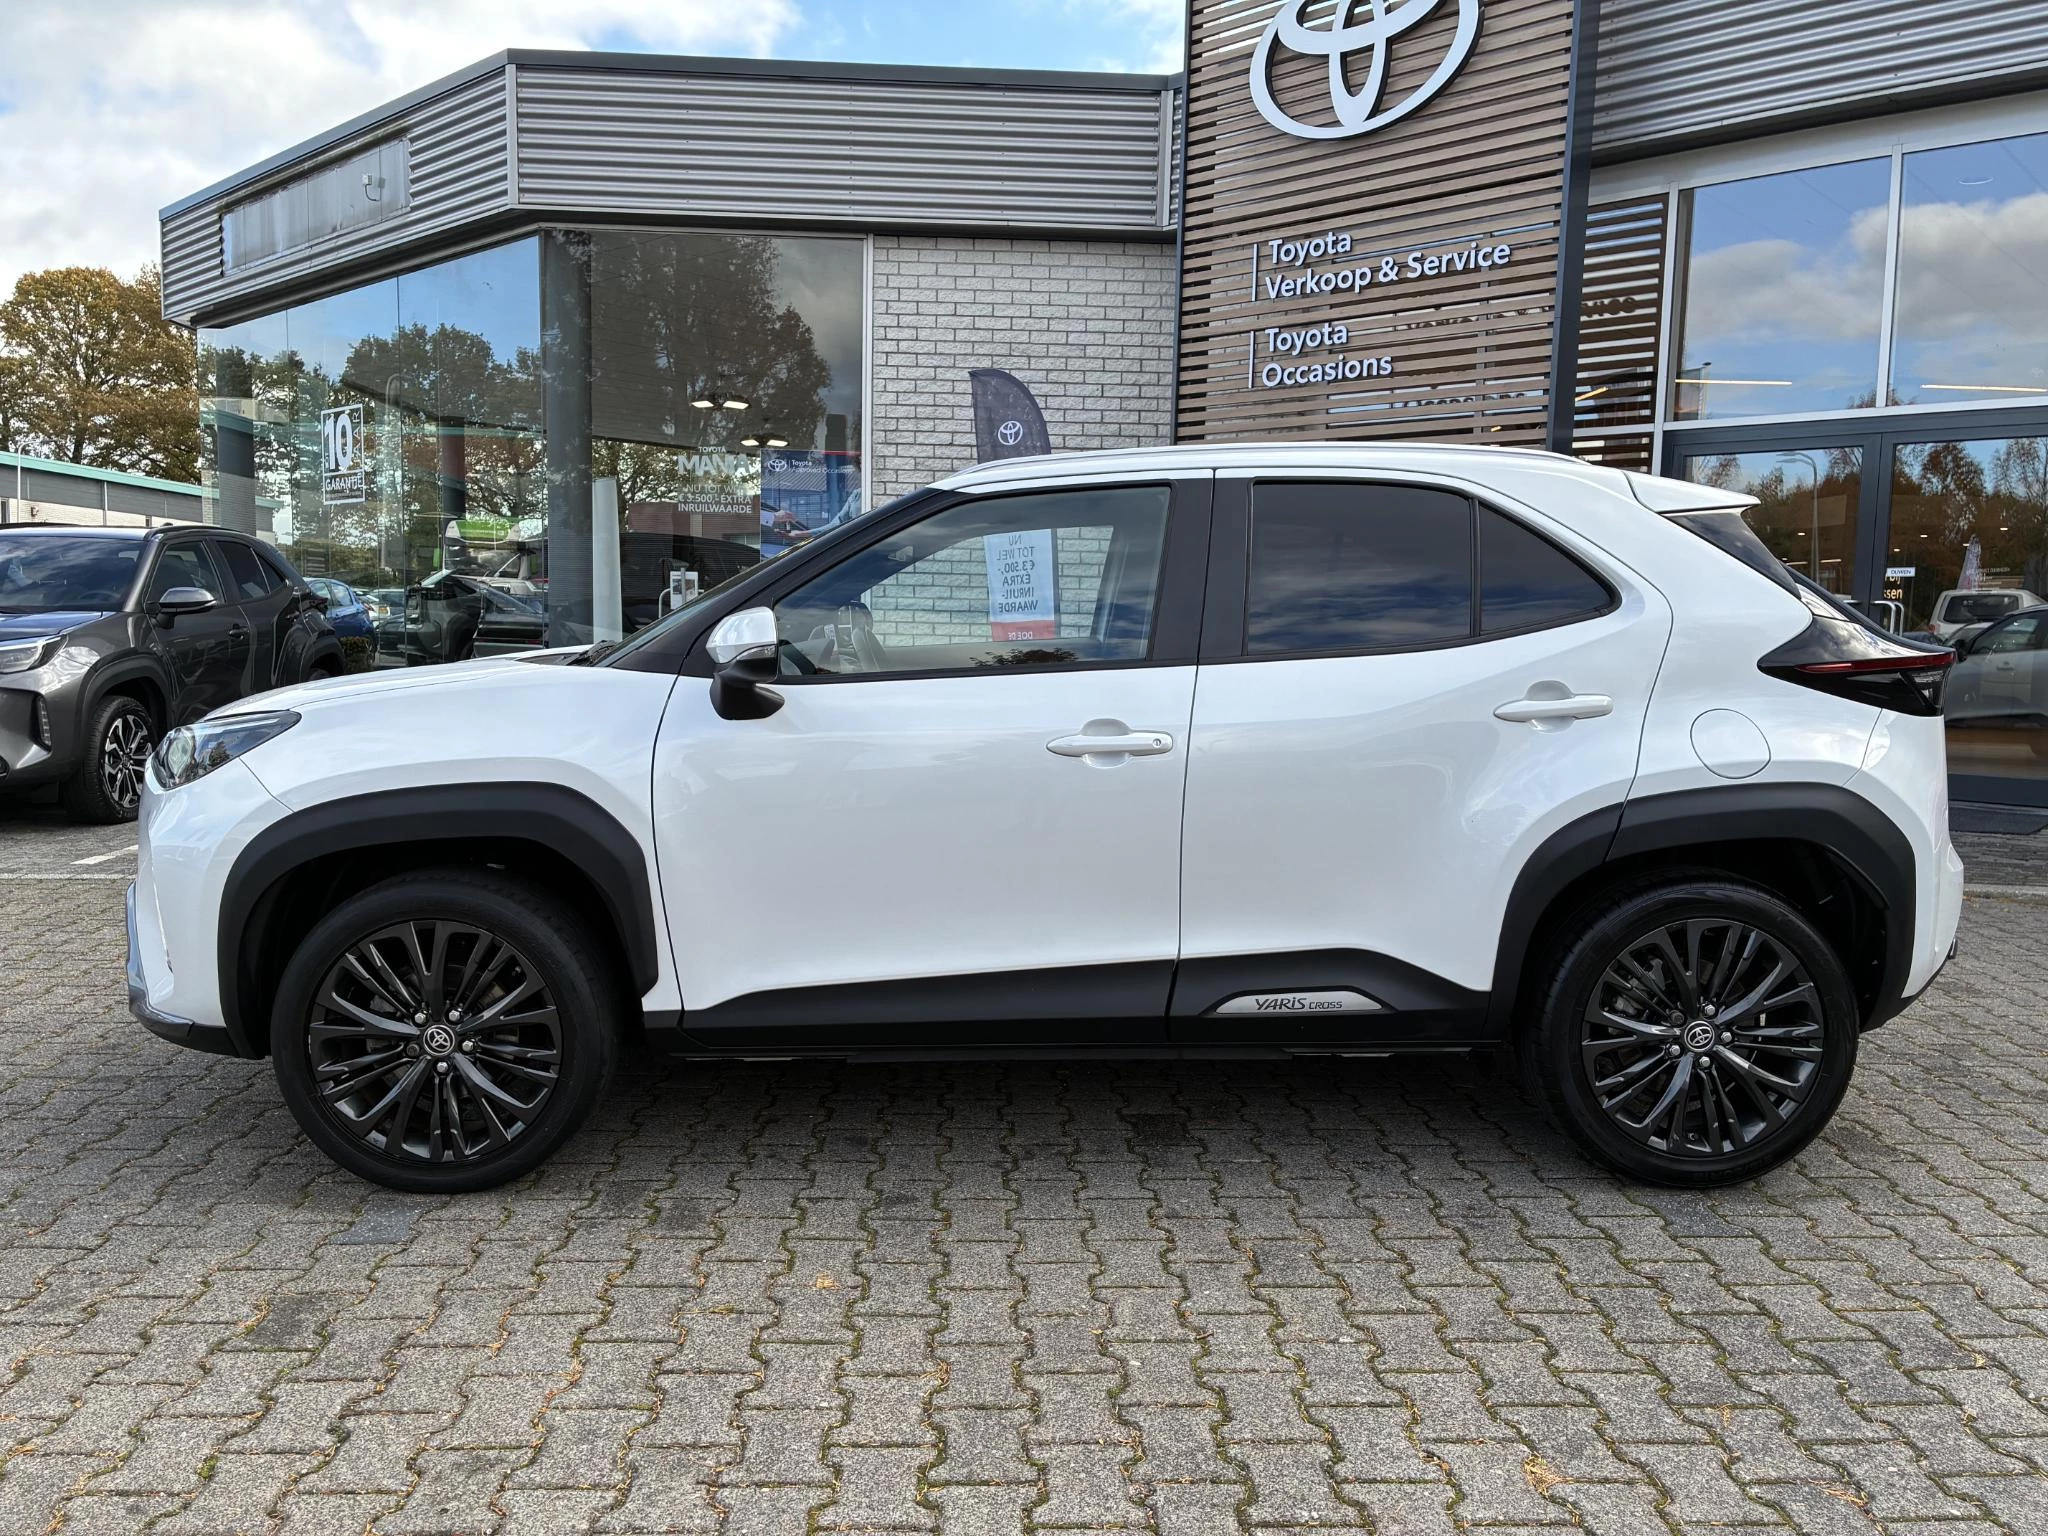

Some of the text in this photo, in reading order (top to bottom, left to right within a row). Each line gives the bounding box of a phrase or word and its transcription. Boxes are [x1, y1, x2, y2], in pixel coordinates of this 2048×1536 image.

[1268, 231, 1352, 267] Toyota
[1265, 241, 1511, 299] Verkoop & Service
[1264, 322, 1349, 356] Toyota
[1261, 353, 1393, 388] Occasions
[324, 413, 353, 470] 10
[678, 453, 750, 476] MANIA
[687, 484, 701, 493] NU
[677, 503, 753, 514] INRUILWAARDE
[1308, 1001, 1343, 1010] CROSS
